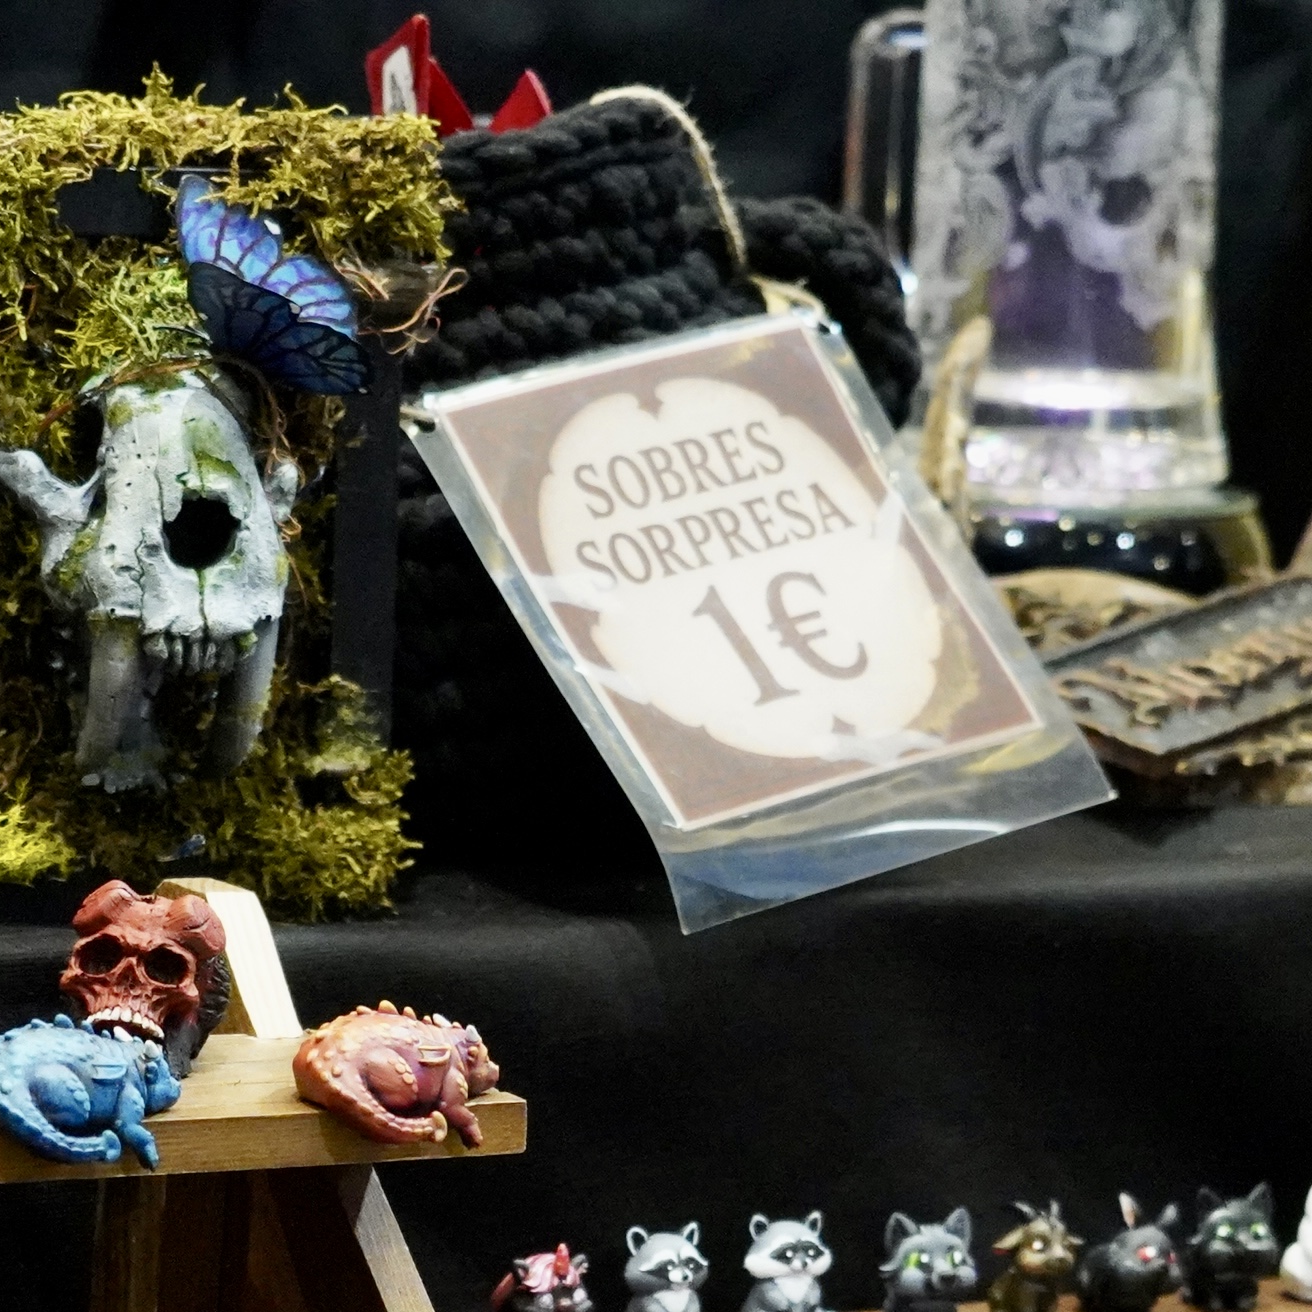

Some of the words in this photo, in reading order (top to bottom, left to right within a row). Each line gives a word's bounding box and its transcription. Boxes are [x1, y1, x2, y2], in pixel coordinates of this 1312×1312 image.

[574, 420, 786, 520] SOBRES
[575, 482, 856, 592] SORPRESA
[692, 570, 869, 707] 1€
